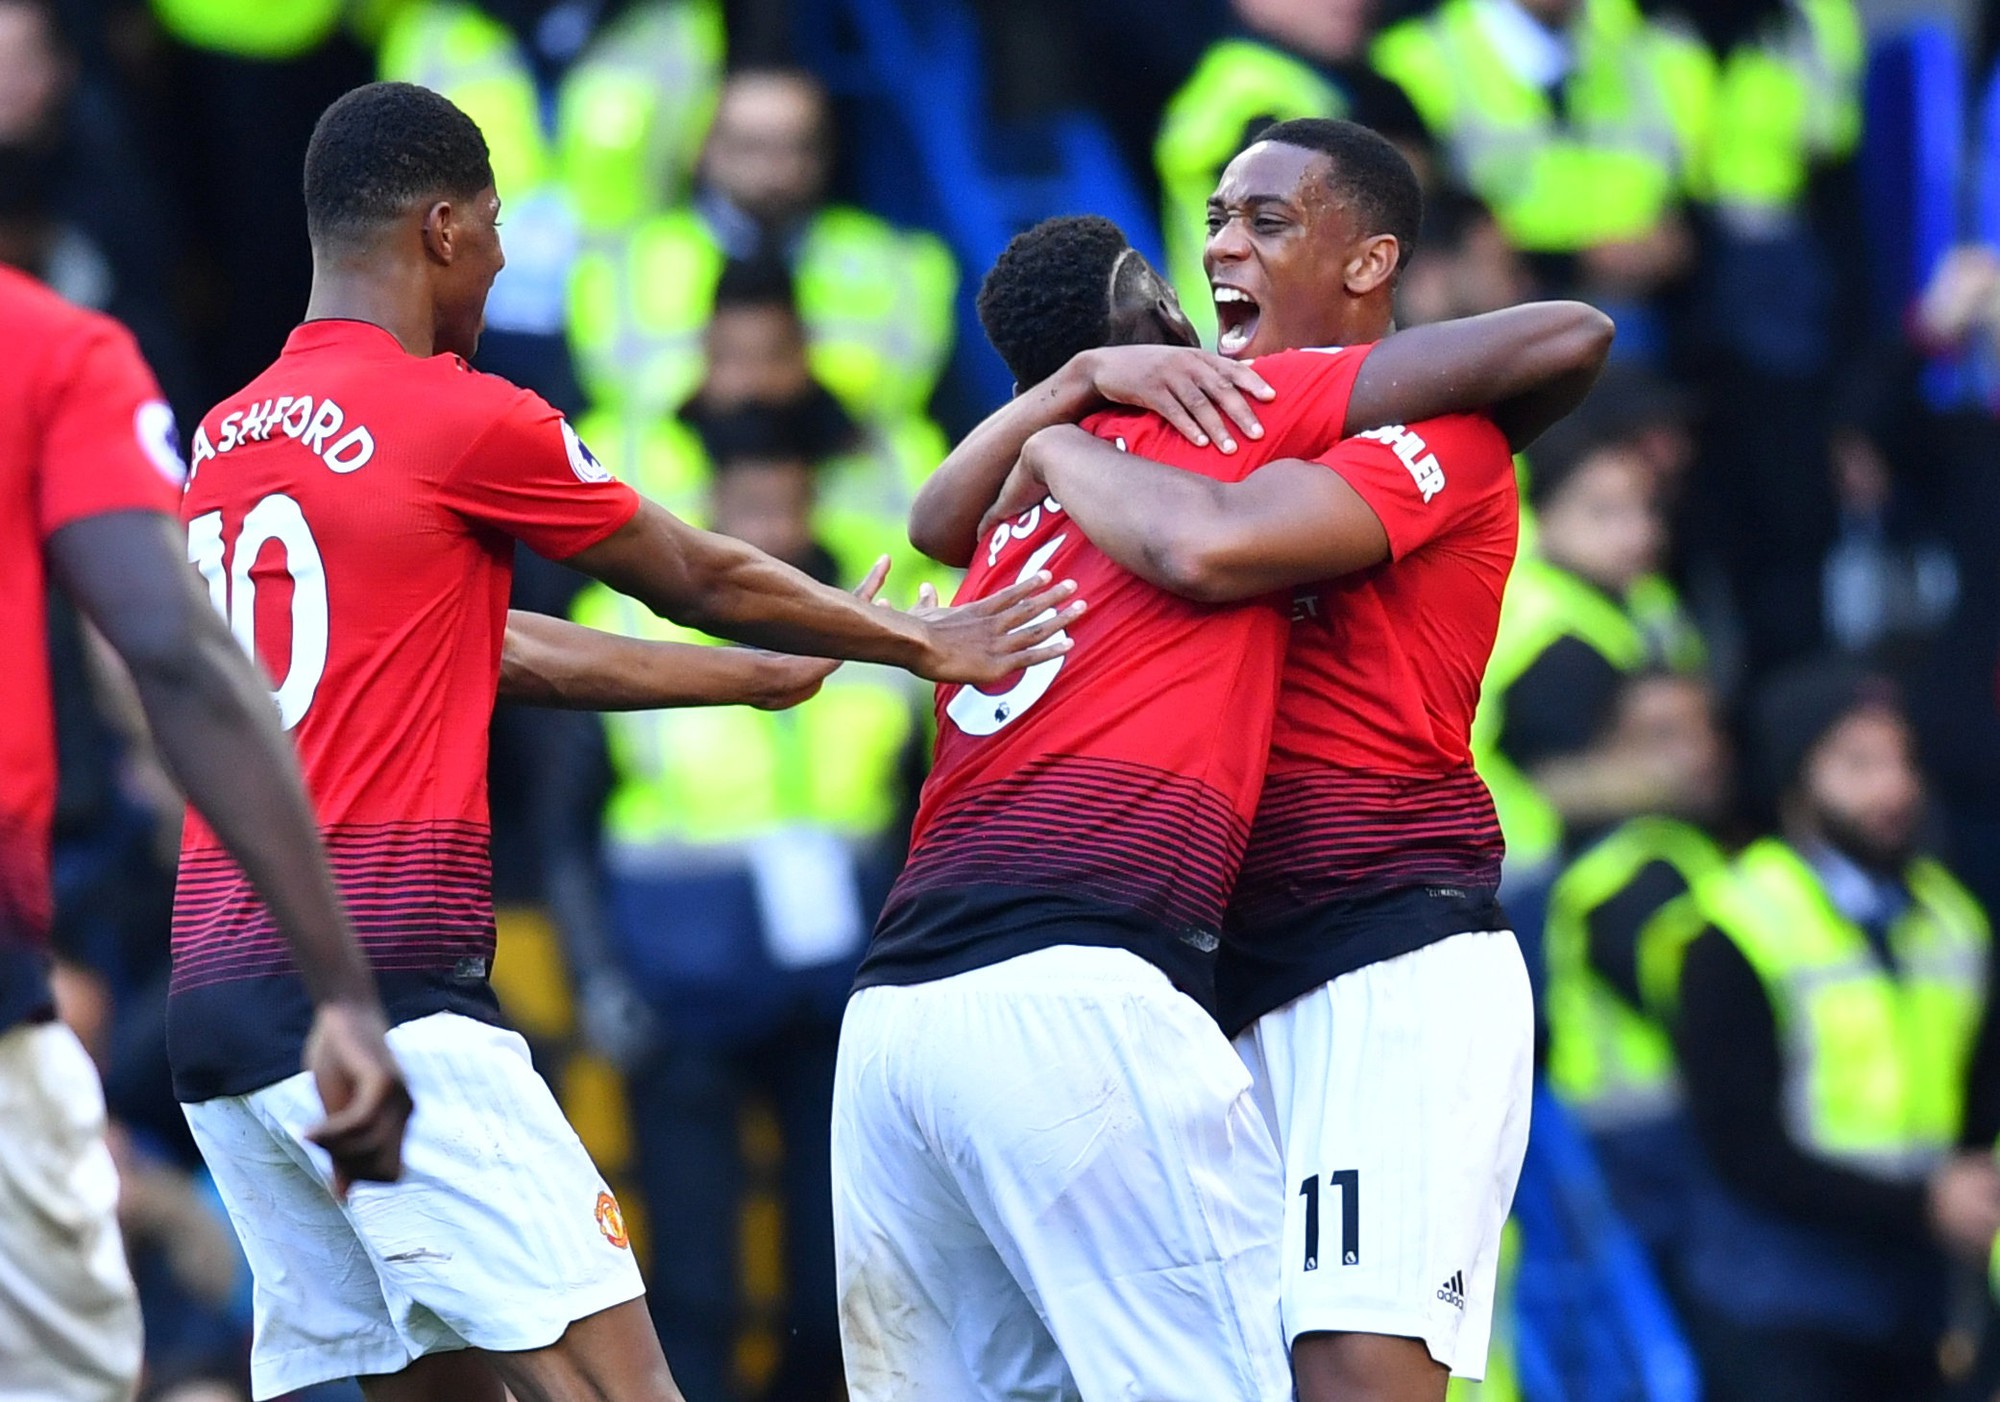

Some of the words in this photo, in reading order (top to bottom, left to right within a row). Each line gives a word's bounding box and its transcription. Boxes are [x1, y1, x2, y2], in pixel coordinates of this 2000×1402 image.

[184, 395, 375, 494] ASHFORD
[187, 493, 329, 732] 10
[1299, 1169, 1359, 1272] 11
[1437, 1289, 1464, 1311] adida
